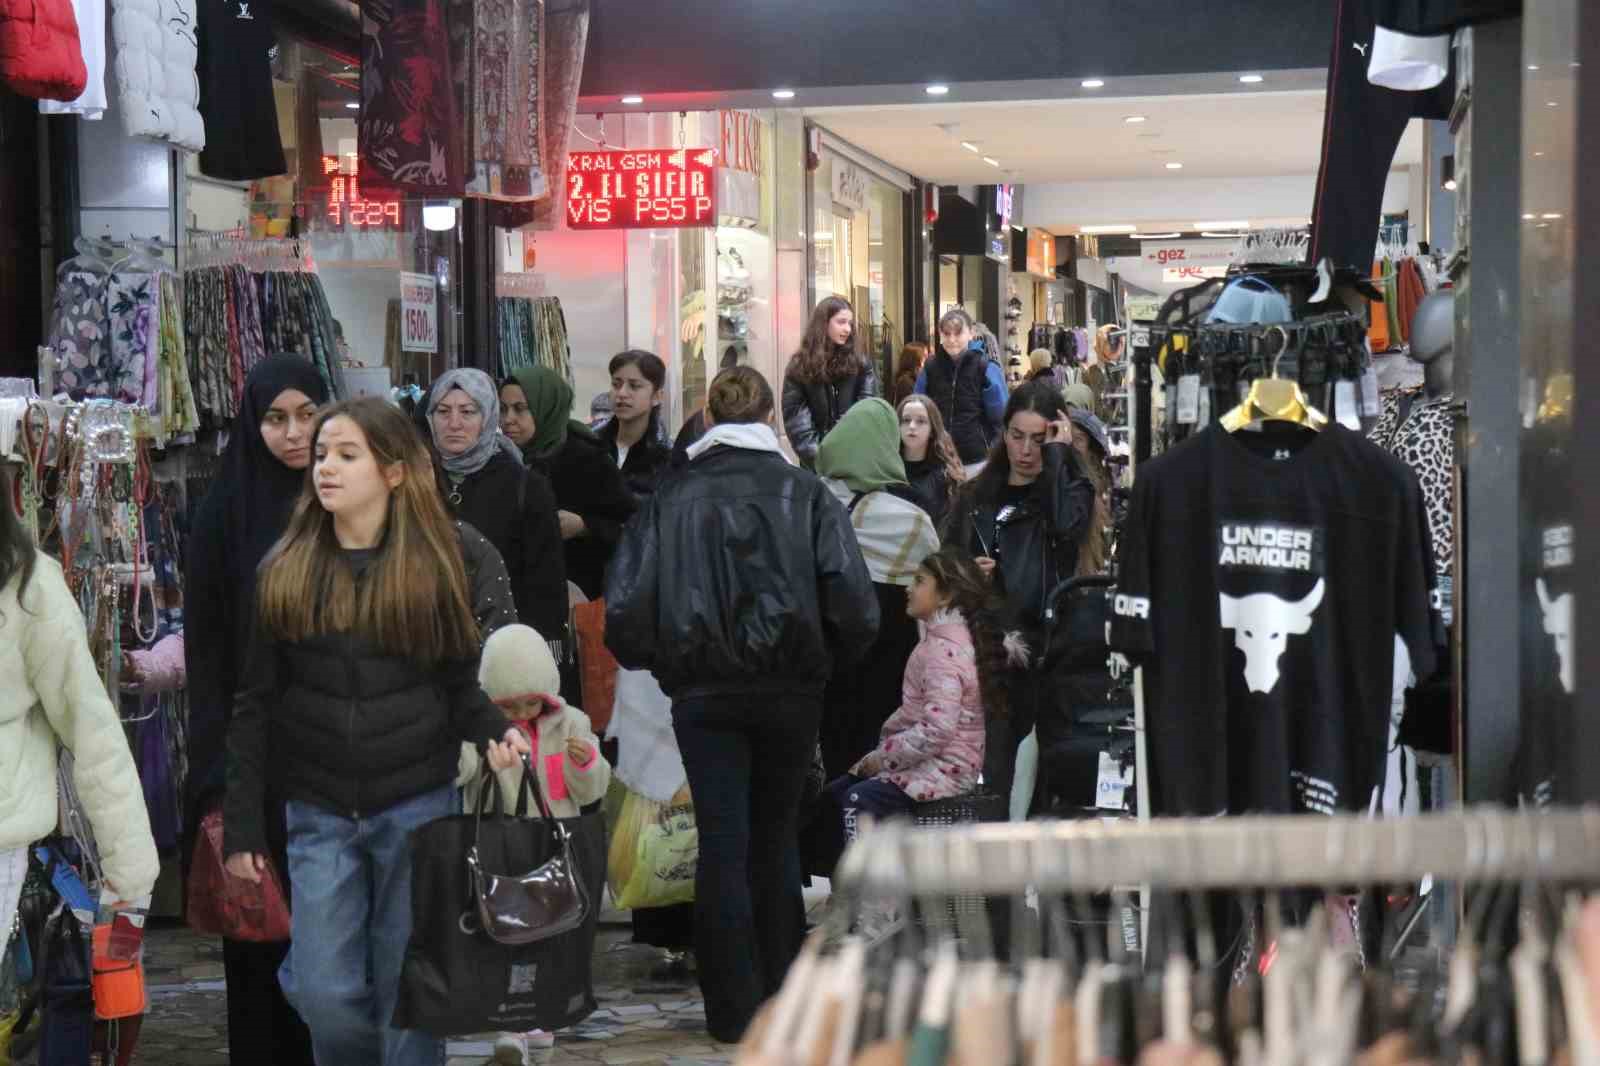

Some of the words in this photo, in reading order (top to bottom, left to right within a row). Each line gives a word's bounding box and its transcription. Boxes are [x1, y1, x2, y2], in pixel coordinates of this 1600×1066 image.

[568, 154, 614, 171] KRAL
[620, 153, 661, 170] GSM
[636, 197, 686, 221] PS5
[695, 196, 711, 220] P
[1158, 248, 1185, 264] gez
[1221, 526, 1313, 550] UNDER
[1219, 545, 1312, 570] ARMOUR
